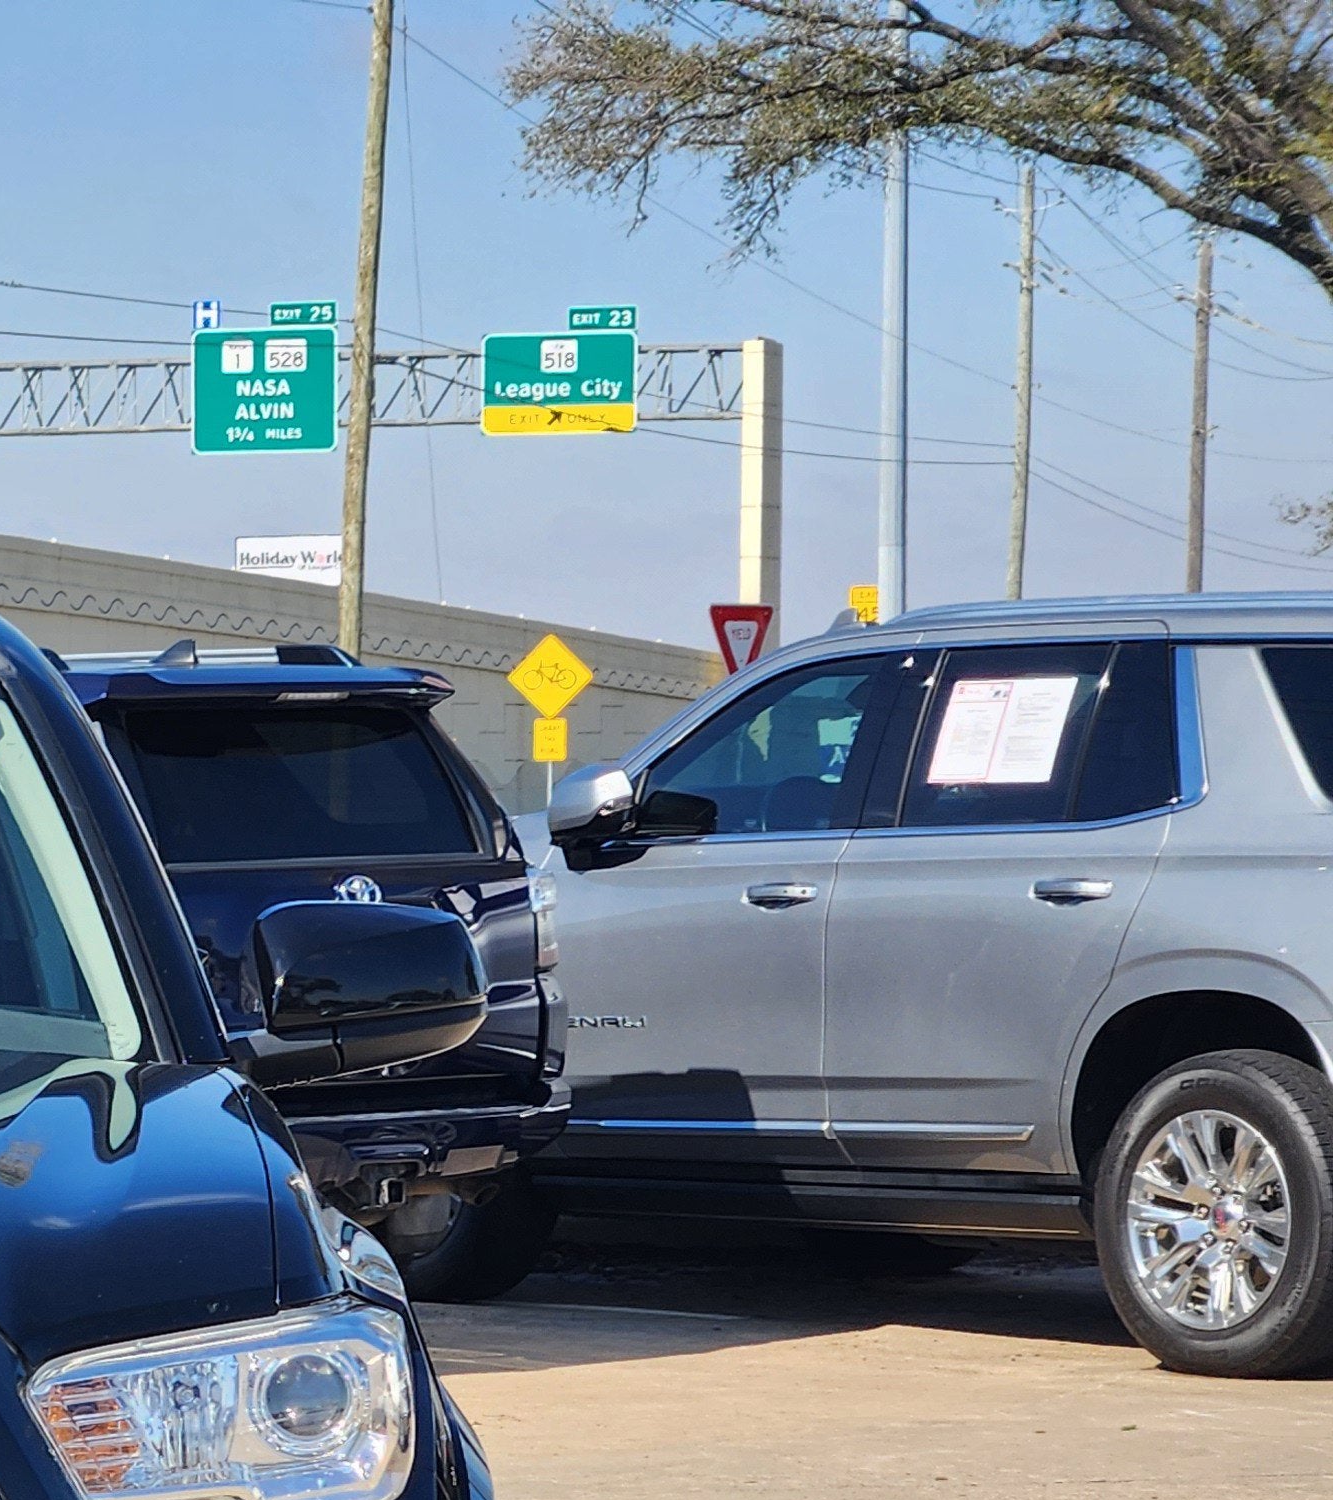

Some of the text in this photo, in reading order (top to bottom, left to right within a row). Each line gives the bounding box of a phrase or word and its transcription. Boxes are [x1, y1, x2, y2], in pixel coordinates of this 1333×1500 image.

[273, 306, 333, 321] EXIT 25
[572, 310, 633, 326] EXIT 23
[269, 351, 304, 369] 528
[544, 352, 576, 369] 518
[235, 378, 291, 397] NASA
[494, 377, 623, 402] League City
[234, 402, 294, 421] ALVIN
[509, 414, 540, 425] EXIT
[265, 428, 302, 439] MILES
[239, 551, 299, 566] Holiday
[567, 1015, 647, 1028] ENALI
